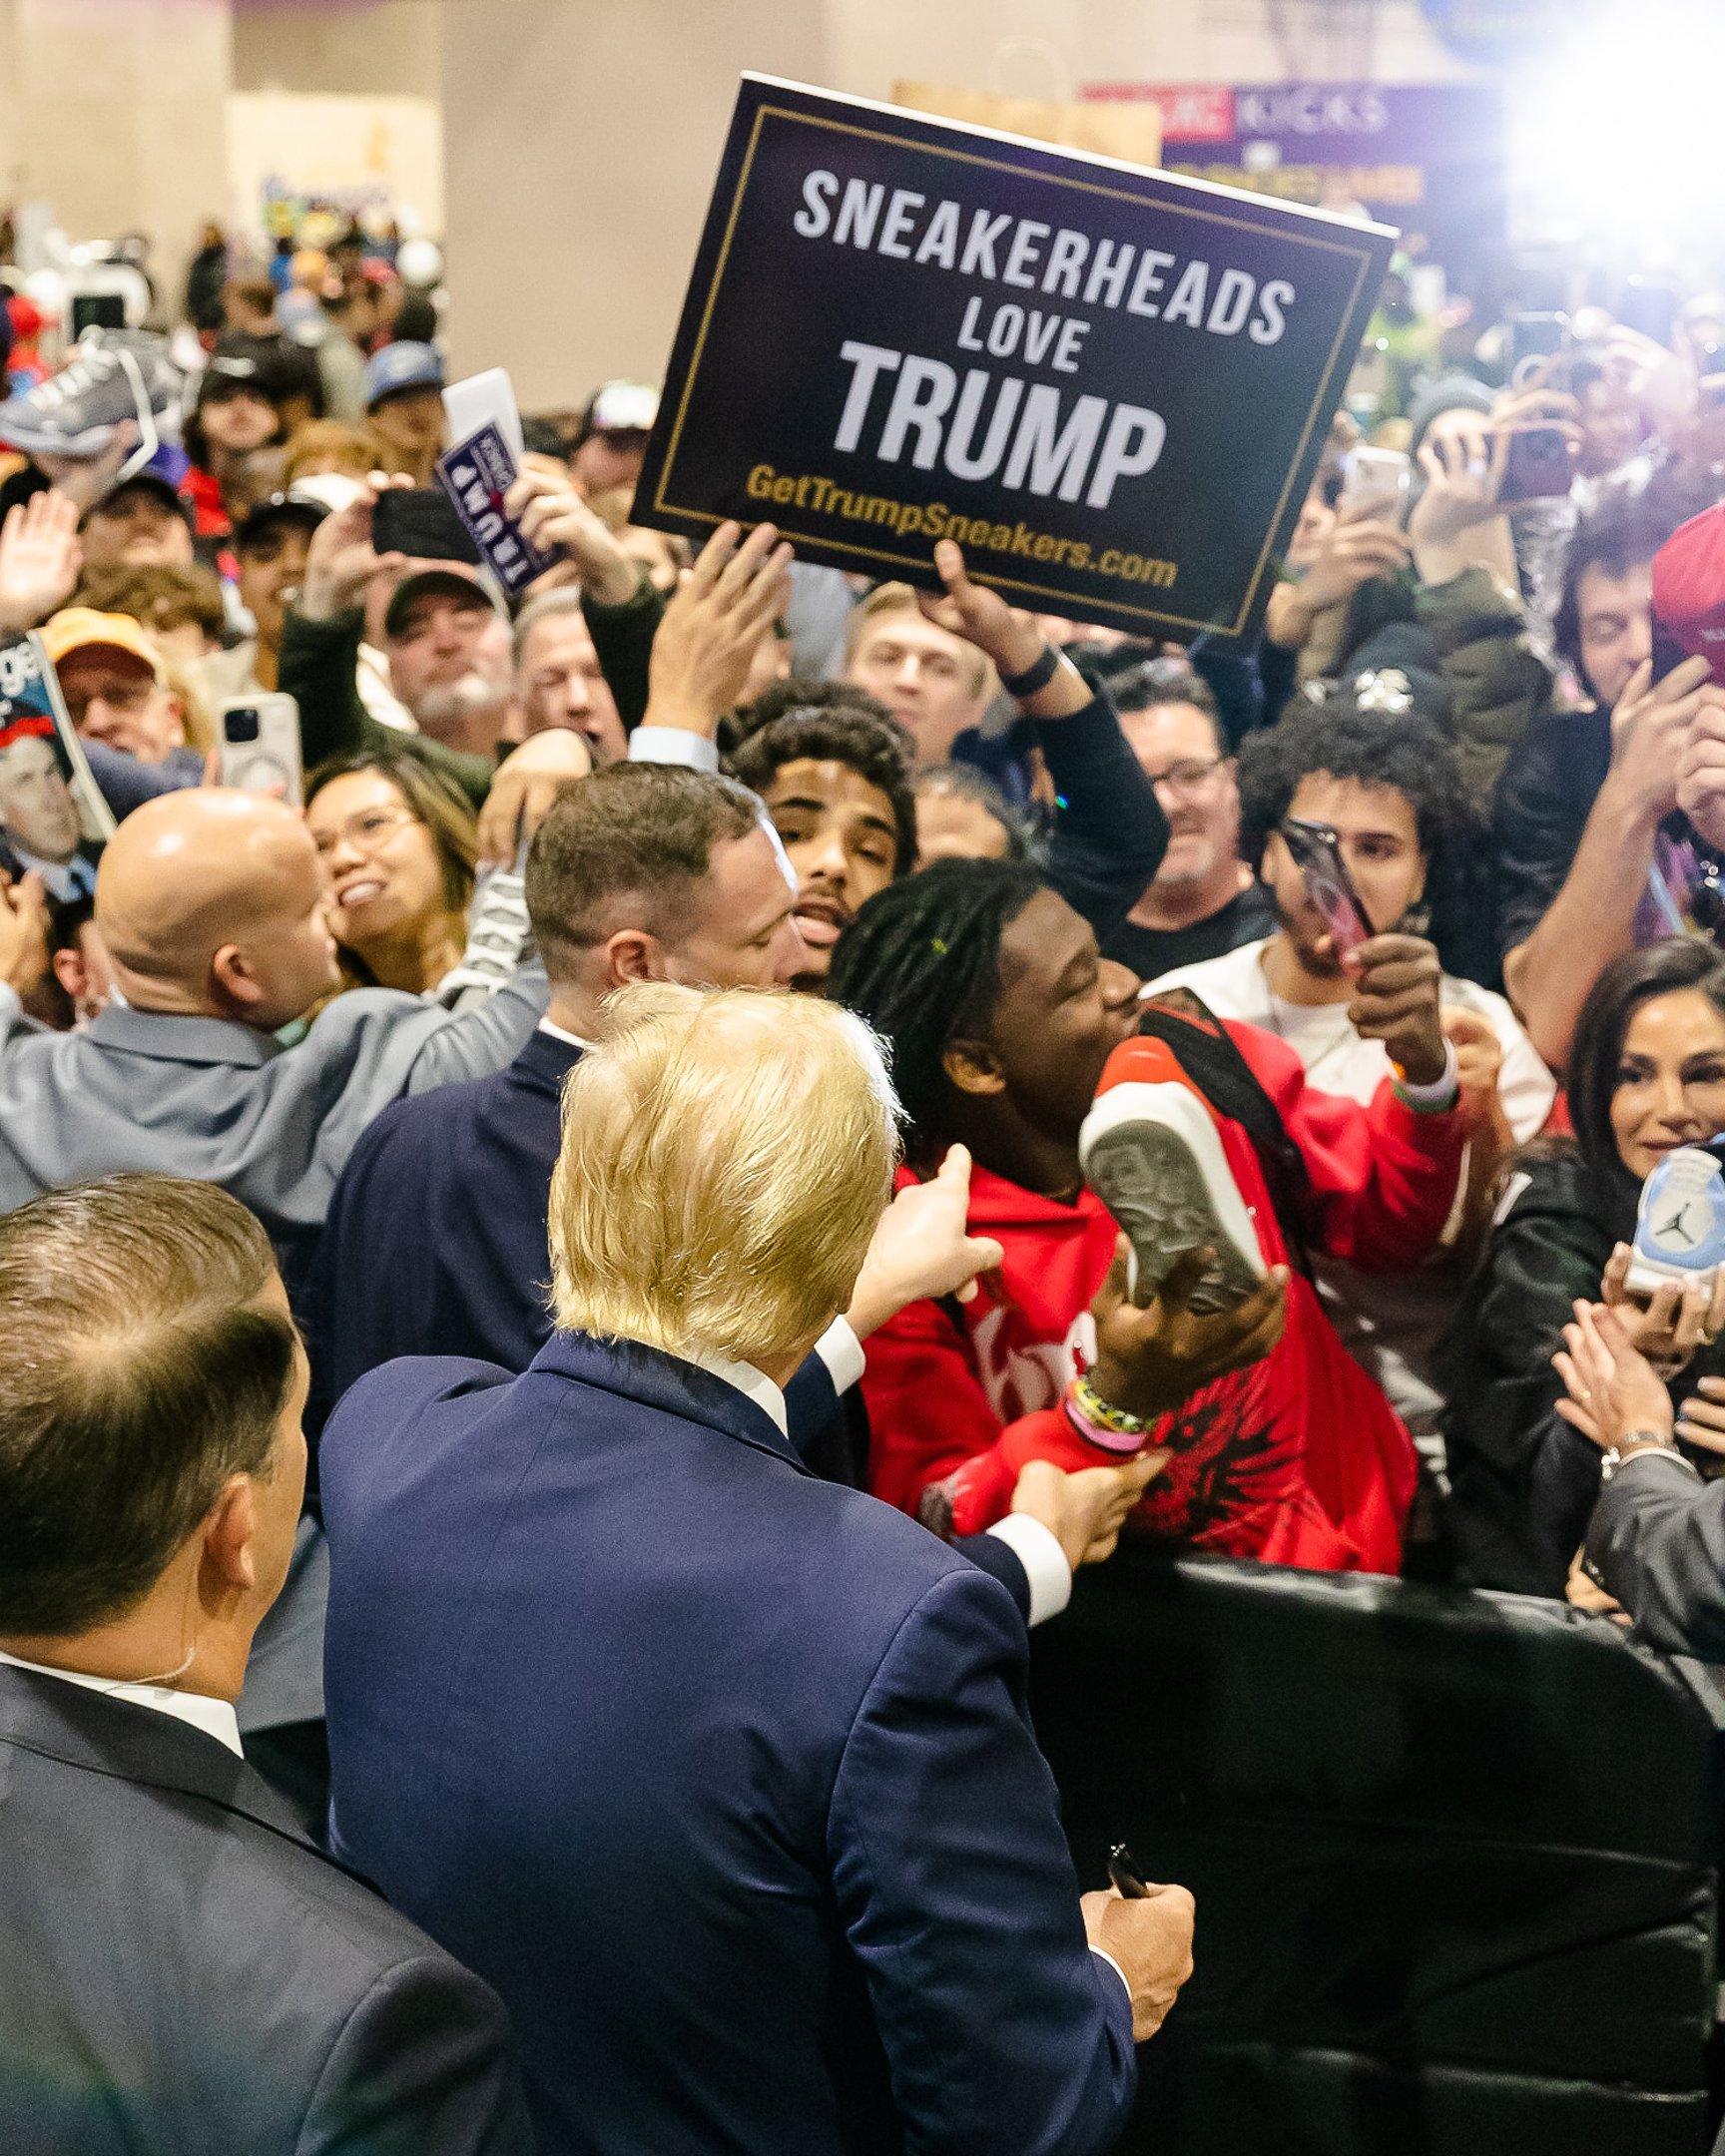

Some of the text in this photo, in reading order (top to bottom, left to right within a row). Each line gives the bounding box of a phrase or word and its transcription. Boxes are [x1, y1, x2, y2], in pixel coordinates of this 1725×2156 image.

[793, 168, 1297, 346] SNEAKERHEADS
[956, 295, 1092, 373] LOVE
[834, 340, 1168, 511] TRUMP
[449, 463, 530, 584] TRUMP
[746, 464, 1179, 589] GetTrumpSneakers.com
